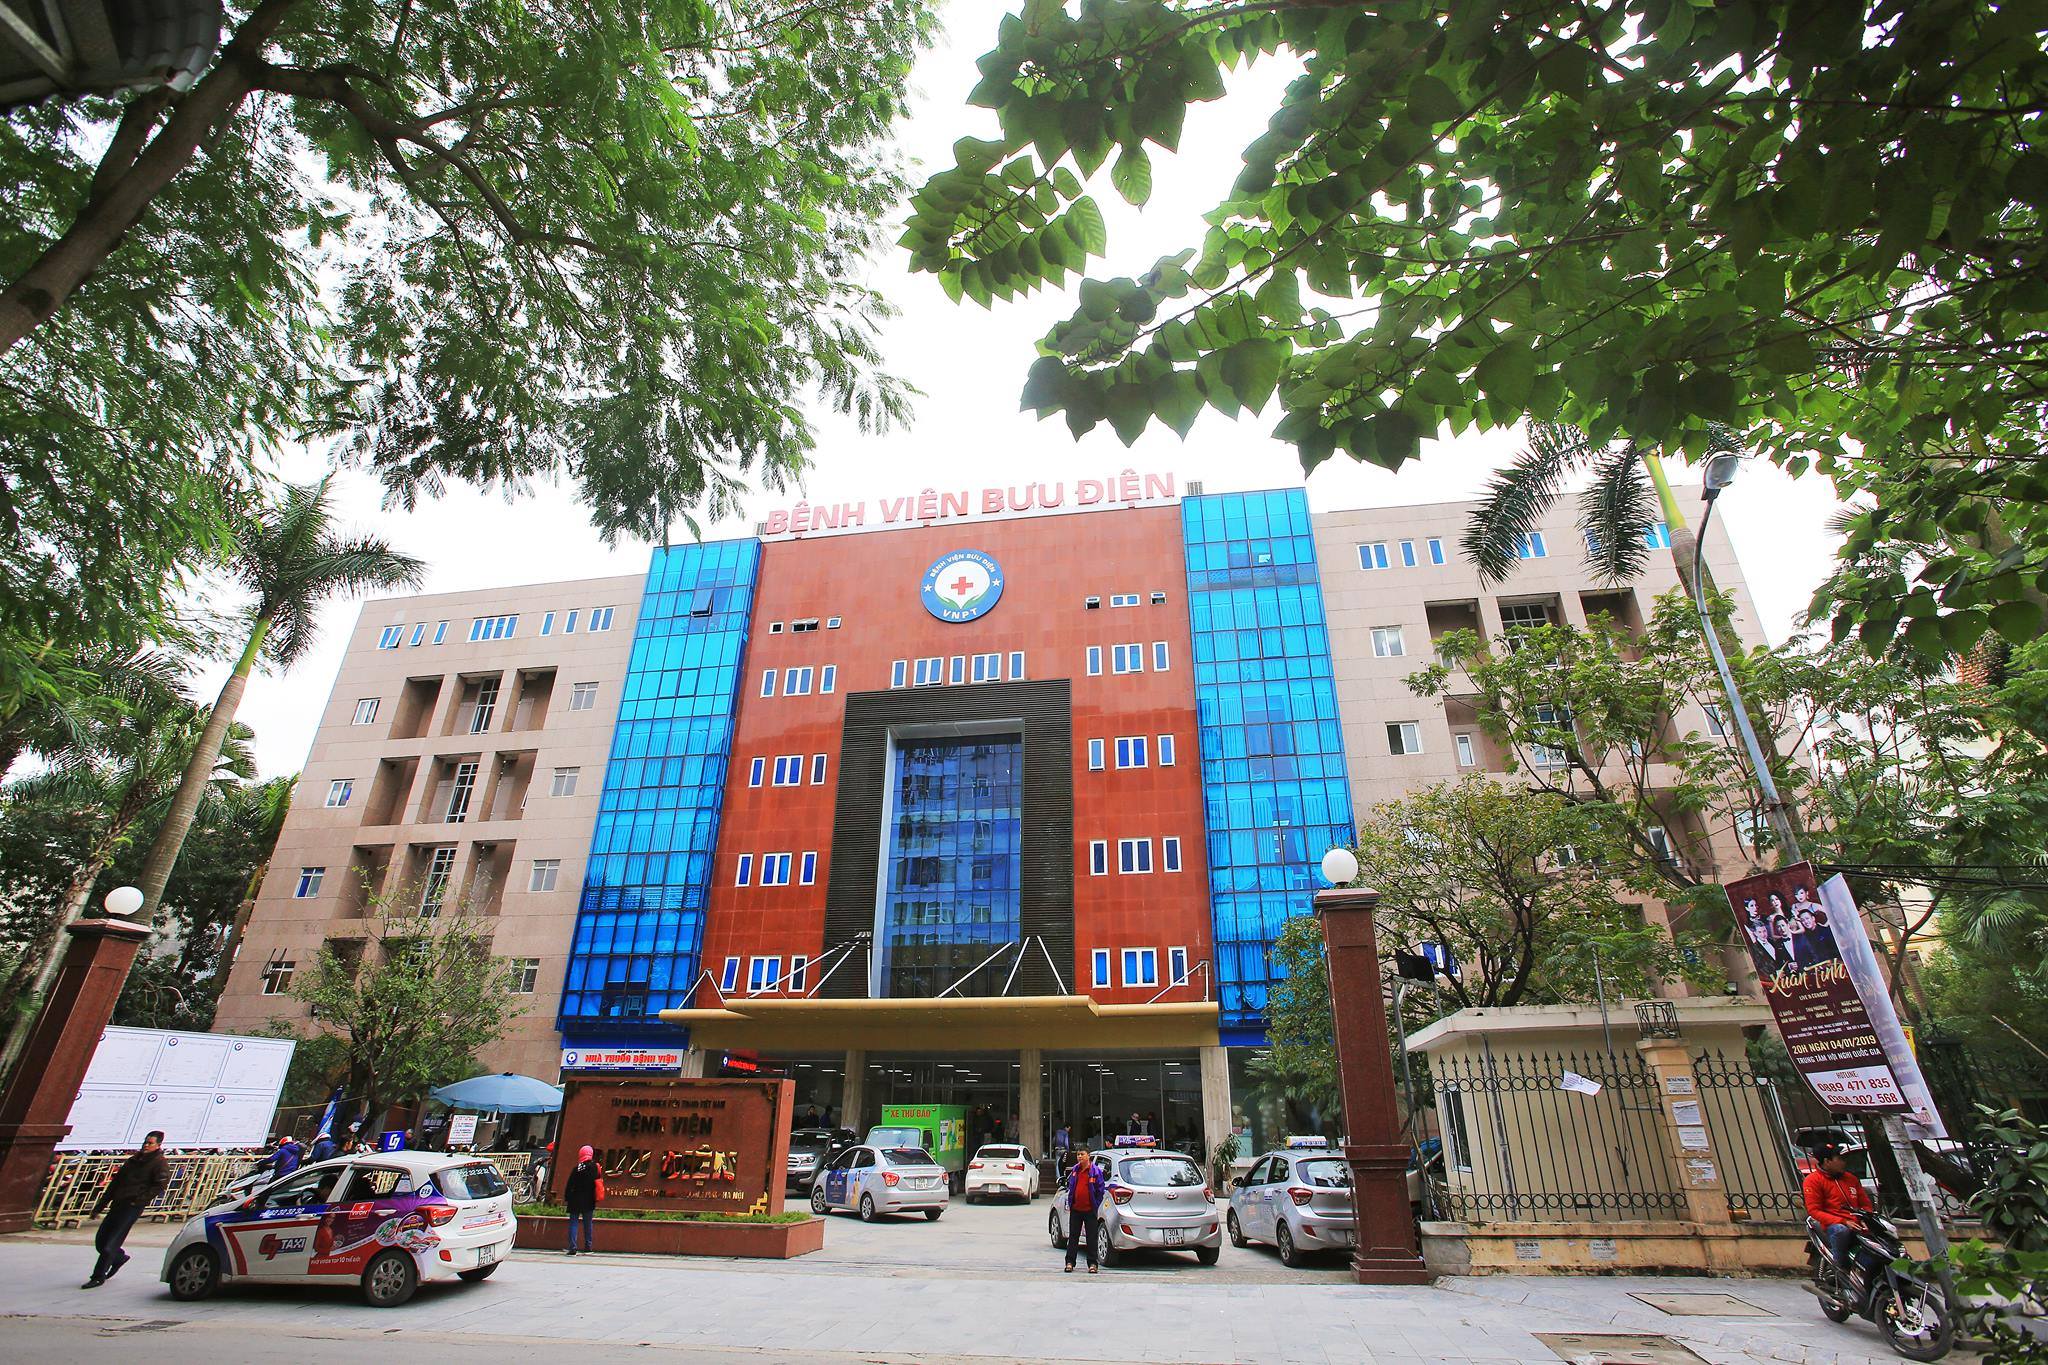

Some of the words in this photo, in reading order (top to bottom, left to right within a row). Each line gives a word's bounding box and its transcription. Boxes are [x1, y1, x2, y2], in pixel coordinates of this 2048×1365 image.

[765, 500, 865, 538] BỆNH
[880, 488, 968, 527] VIỆN
[982, 482, 1064, 514] BƯU
[1075, 468, 1174, 509] ĐIỆN
[943, 608, 978, 619] VNPT
[1792, 1044, 1808, 1054] 20H
[1808, 1041, 1831, 1052] NGÀY
[1830, 1035, 1876, 1049] 04/01/2019
[1852, 1048, 1869, 1057] QUỐC
[1847, 1080, 1866, 1091] 471
[1869, 1078, 1890, 1088] 835
[1853, 1094, 1876, 1105] 302
[1876, 1092, 1898, 1103] 568
[891, 1109, 899, 1117] XE
[671, 1112, 713, 1141] VIỆN
[389, 1133, 400, 1150] G7
[281, 1238, 306, 1249] TAXI
